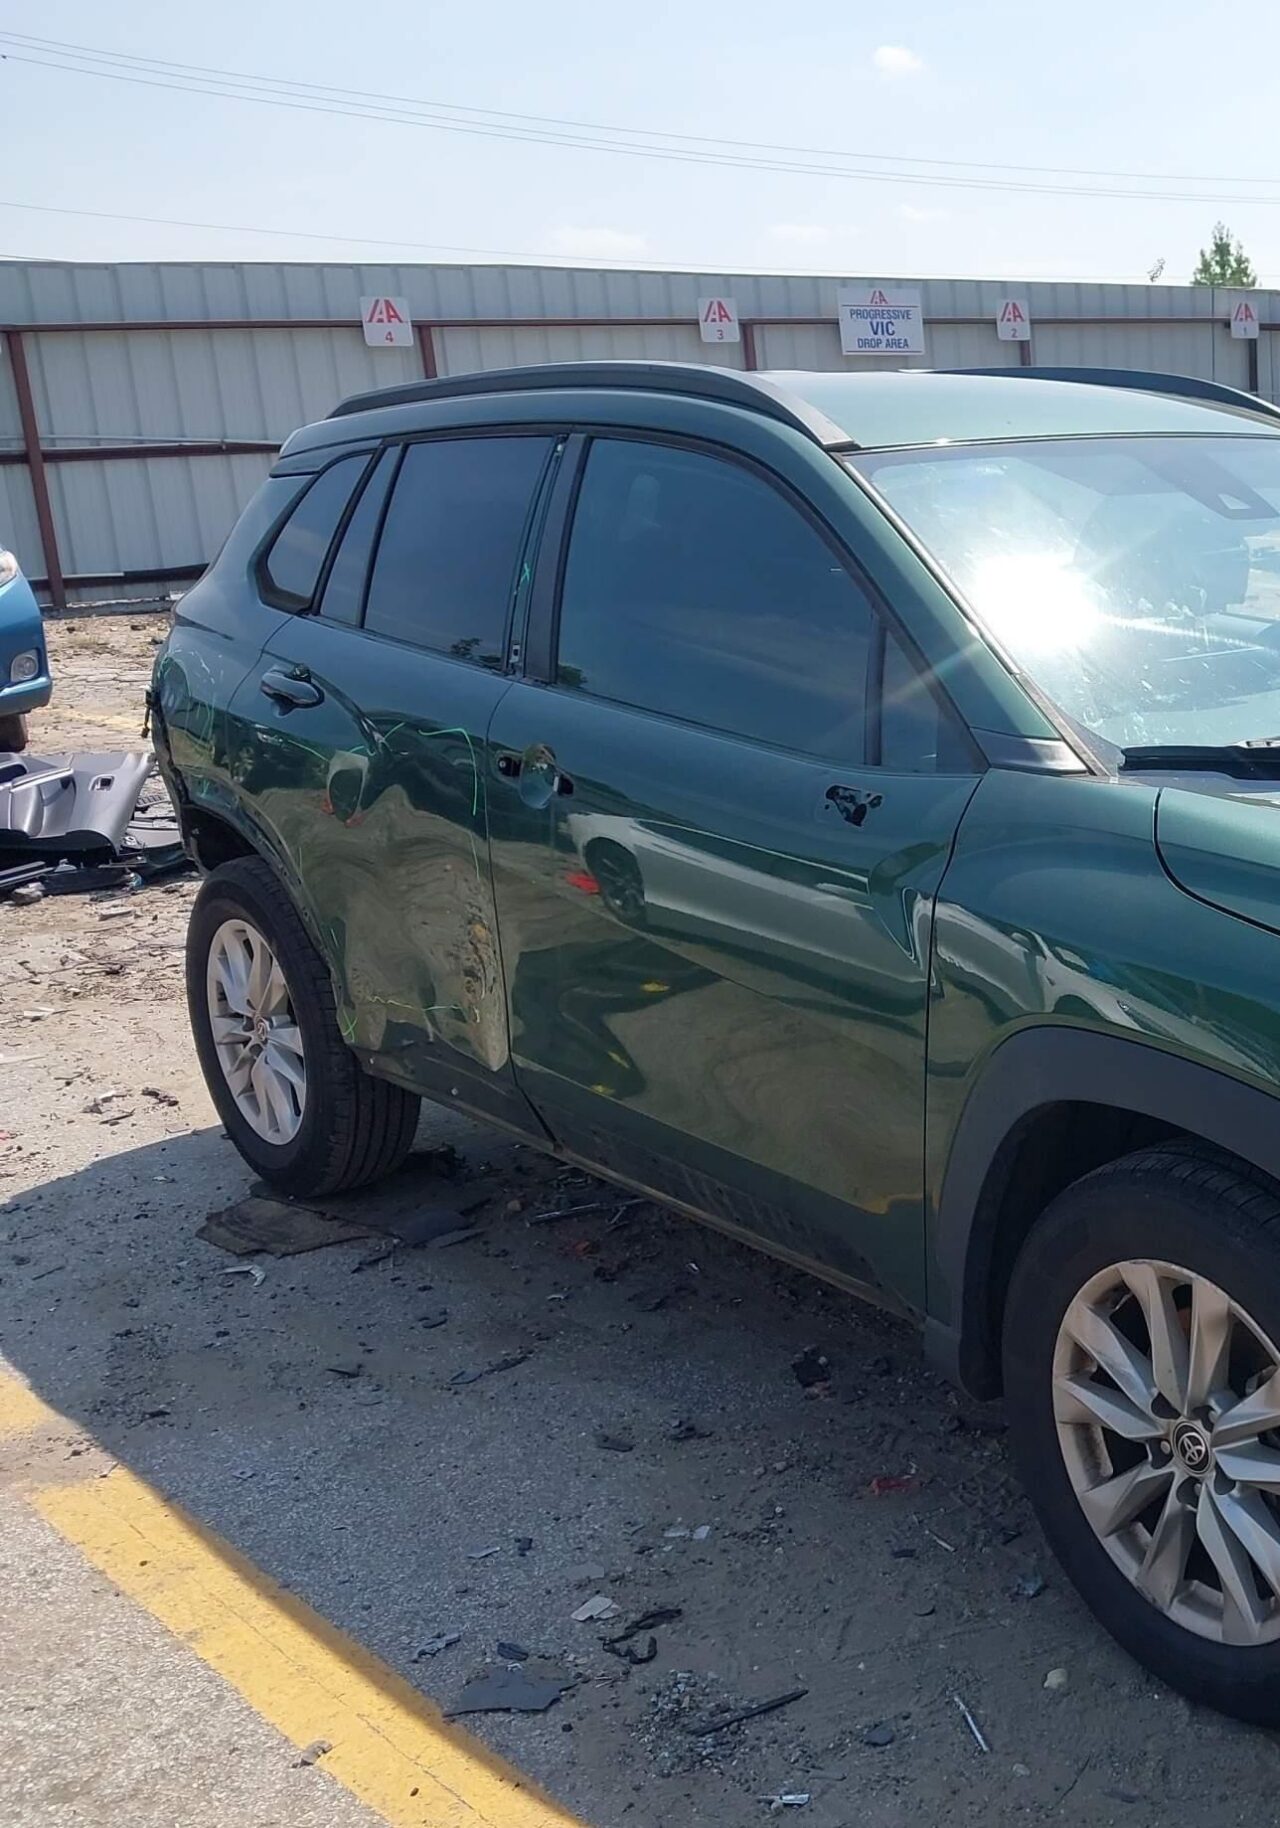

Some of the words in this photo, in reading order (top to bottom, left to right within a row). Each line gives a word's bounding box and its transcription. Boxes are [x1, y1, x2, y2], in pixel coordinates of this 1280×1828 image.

[849, 309, 913, 320] PROGRESSIVE
[869, 321, 896, 336] VIC
[1010, 328, 1019, 338] 2
[384, 331, 394, 342] 4
[716, 330, 725, 340] 3
[857, 338, 883, 349] DROP
[884, 338, 910, 349] AREA
